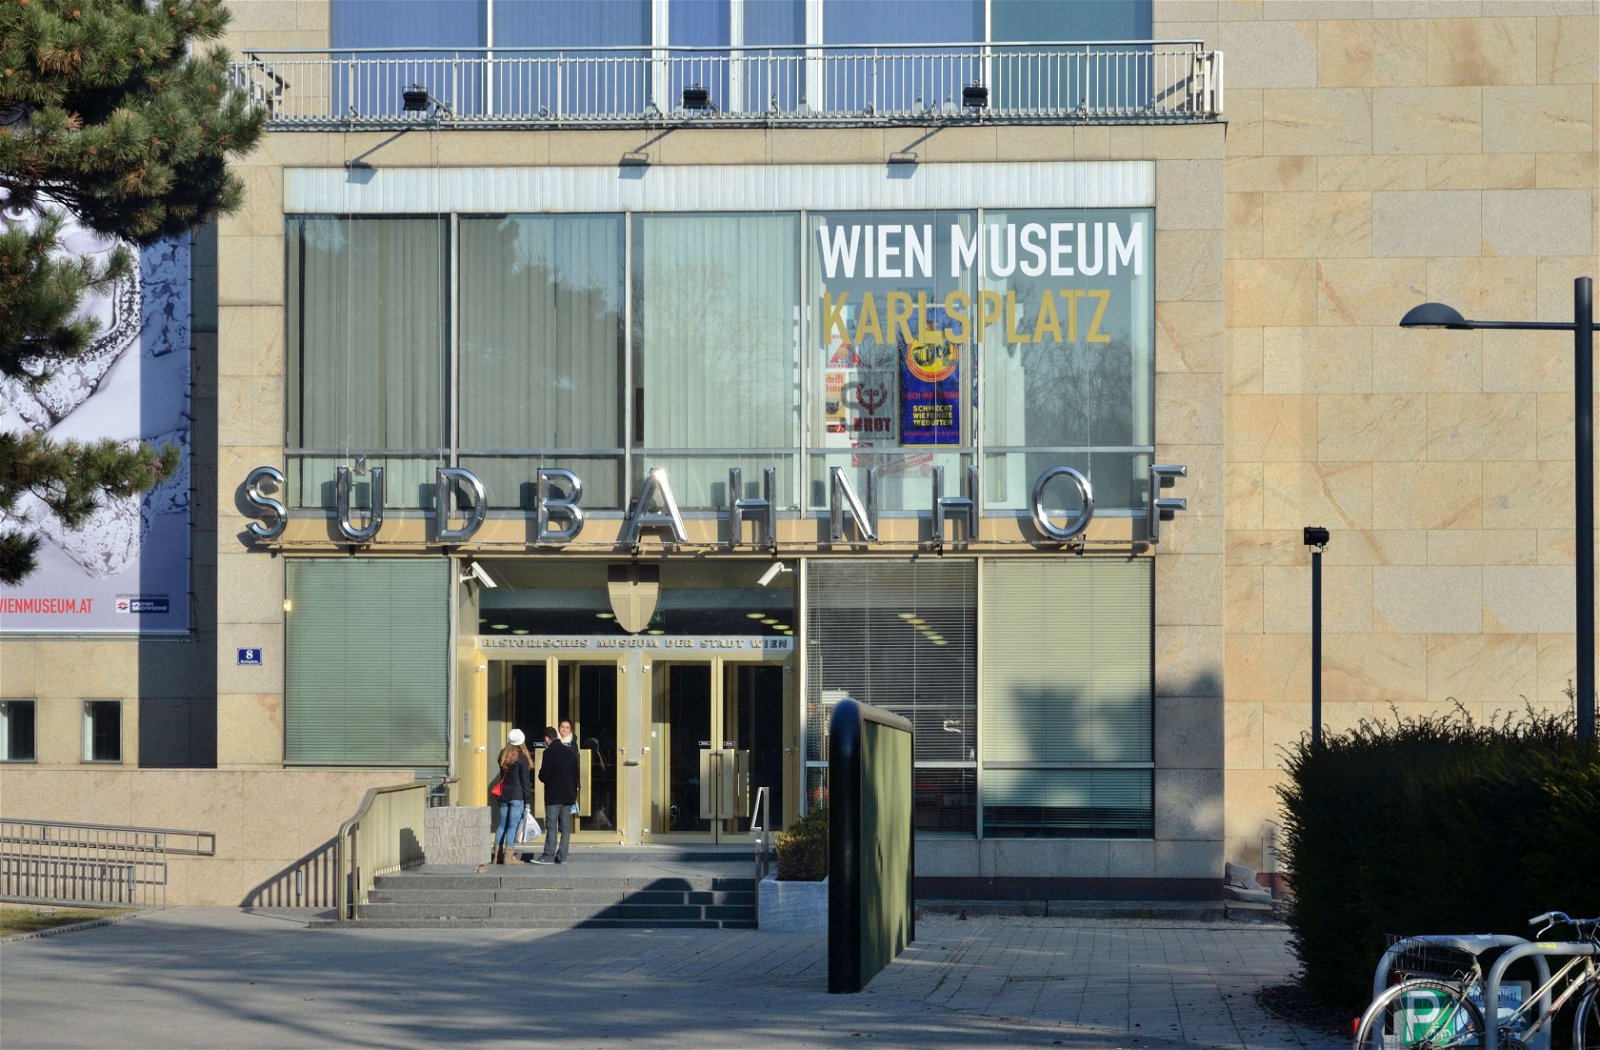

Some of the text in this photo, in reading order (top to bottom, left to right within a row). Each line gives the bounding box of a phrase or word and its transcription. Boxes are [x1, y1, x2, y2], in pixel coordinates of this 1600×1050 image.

[819, 222, 1144, 278] WIEN MUSEUM
[822, 289, 1112, 345] KARLSPLATZ
[246, 649, 254, 660] 8
[482, 638, 789, 648] HISTORISCHES MUSEUM DER STADT WIEN
[1407, 990, 1440, 1042] P
